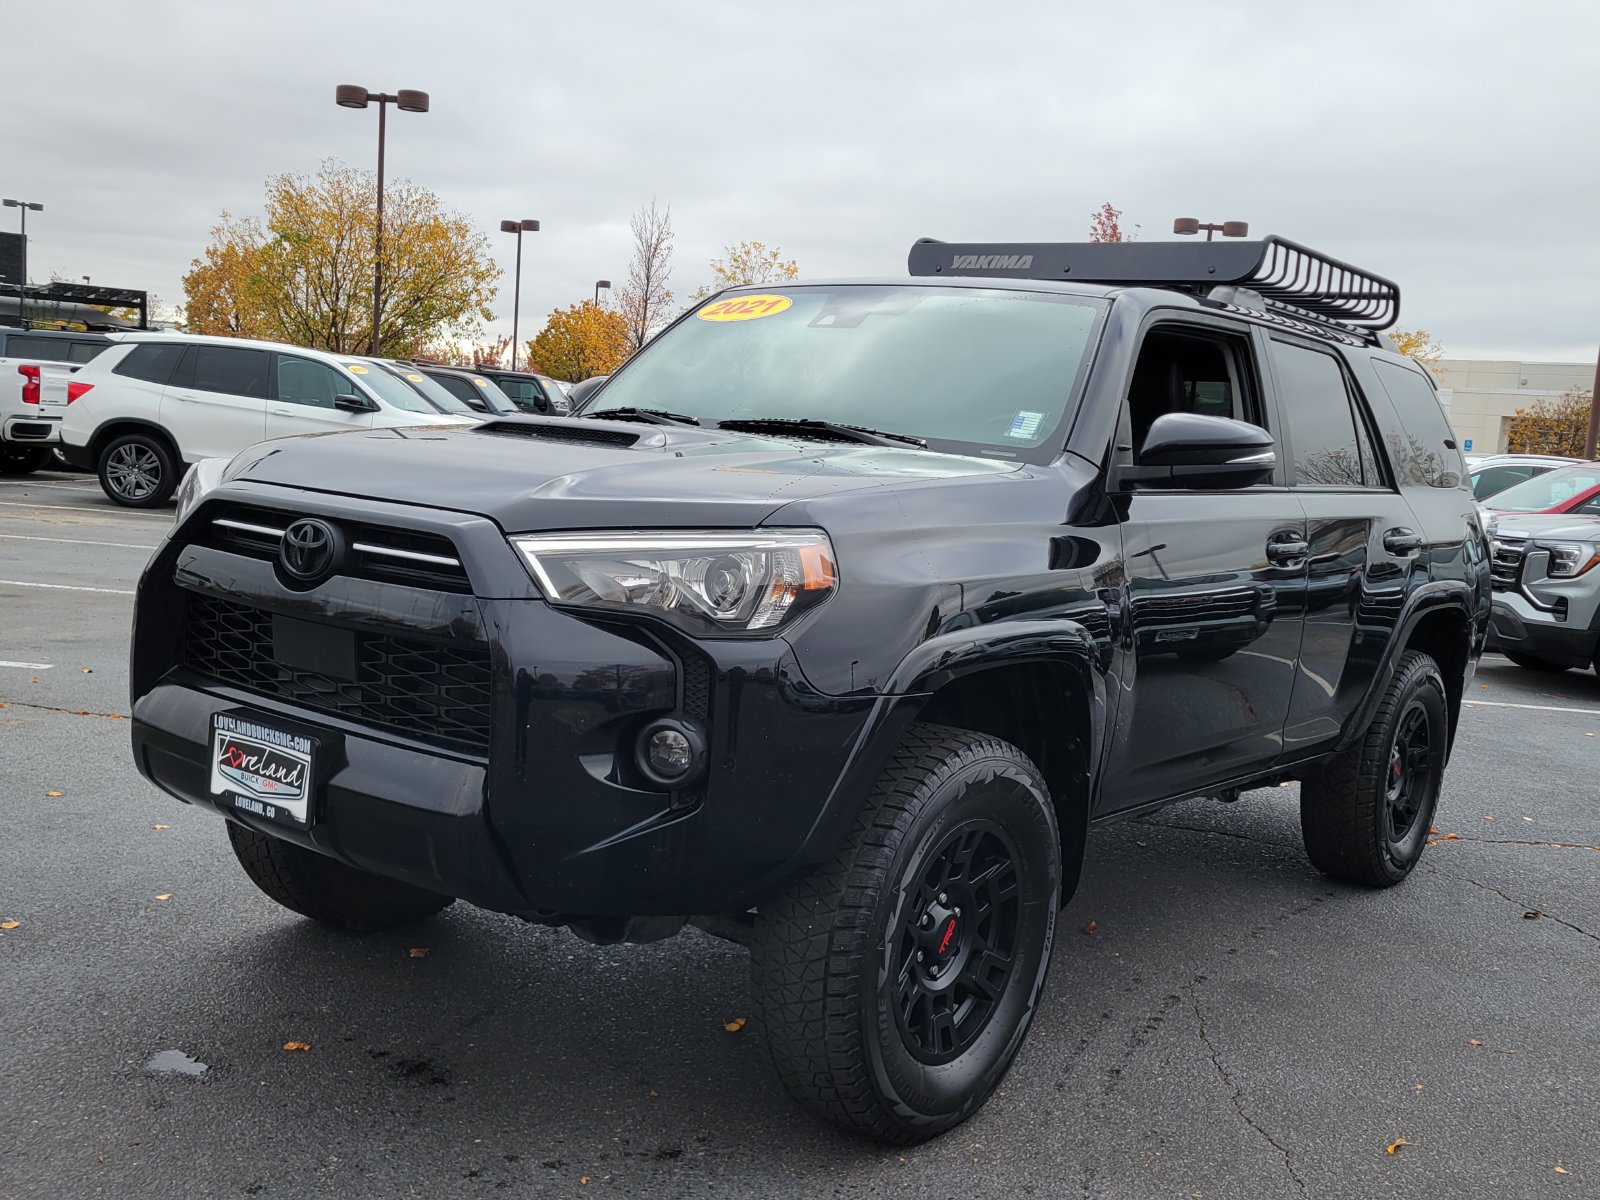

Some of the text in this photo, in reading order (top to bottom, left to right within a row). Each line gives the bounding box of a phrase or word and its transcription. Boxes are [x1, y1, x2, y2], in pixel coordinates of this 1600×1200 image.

[951, 255, 1033, 269] YAKIMA
[703, 299, 784, 316] 2021
[218, 735, 302, 786] Loveland
[240, 772, 279, 791] BUICK GMC
[266, 807, 276, 818] CO
